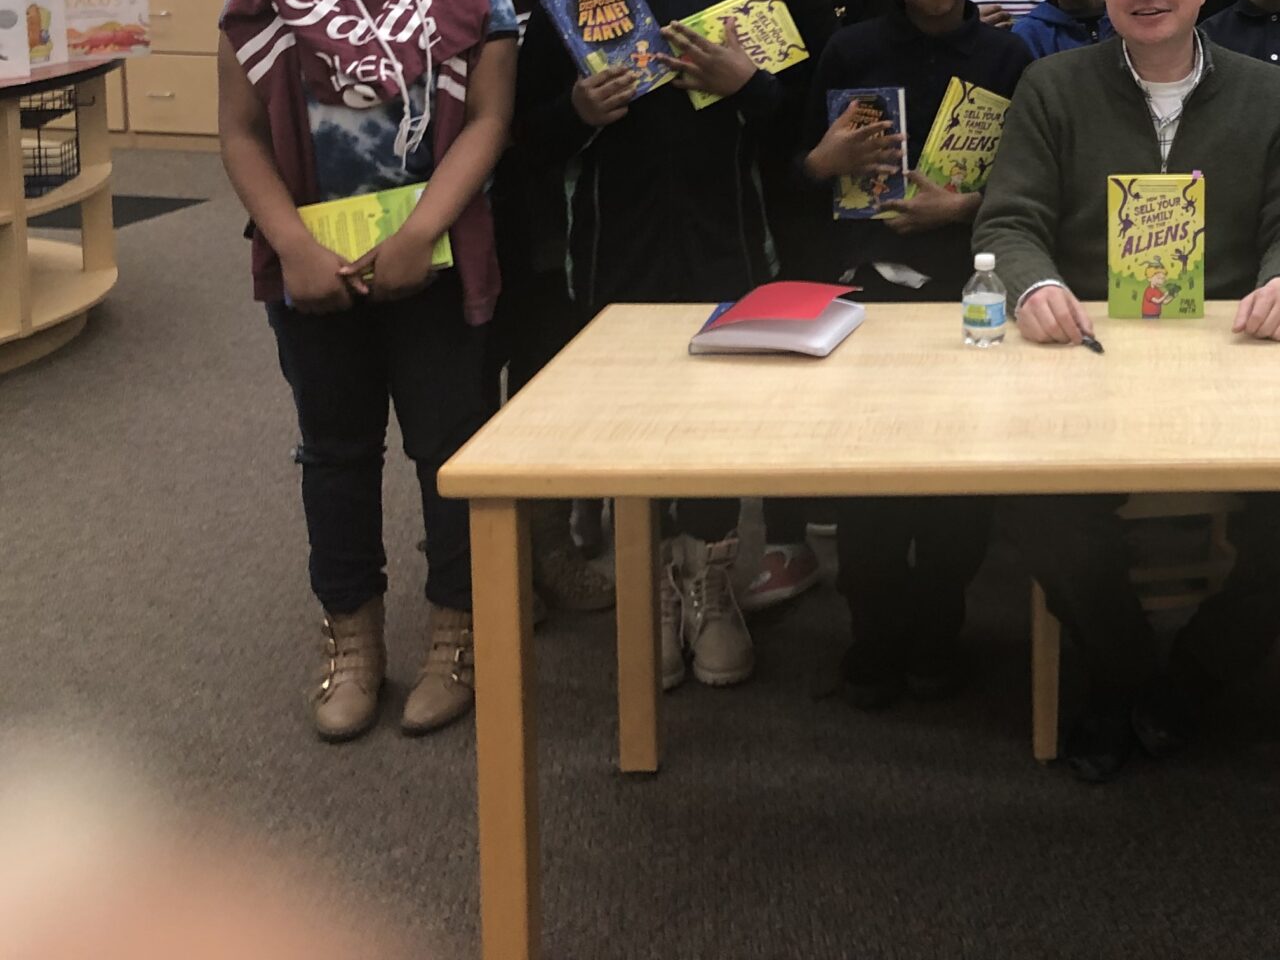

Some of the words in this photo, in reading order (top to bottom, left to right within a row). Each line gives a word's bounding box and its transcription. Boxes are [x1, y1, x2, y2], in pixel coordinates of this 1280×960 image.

[578, 0, 630, 27] PLANET
[583, 15, 635, 42] EARTH
[963, 110, 981, 119] SELL
[982, 112, 1001, 122] YOUR
[965, 121, 993, 130] FAMILY
[939, 135, 1000, 153] ALIENS
[1134, 202, 1155, 216] SELL
[1156, 197, 1181, 211] YOUR
[1141, 209, 1173, 225] FAMILY
[1121, 220, 1190, 259] ALIENS
